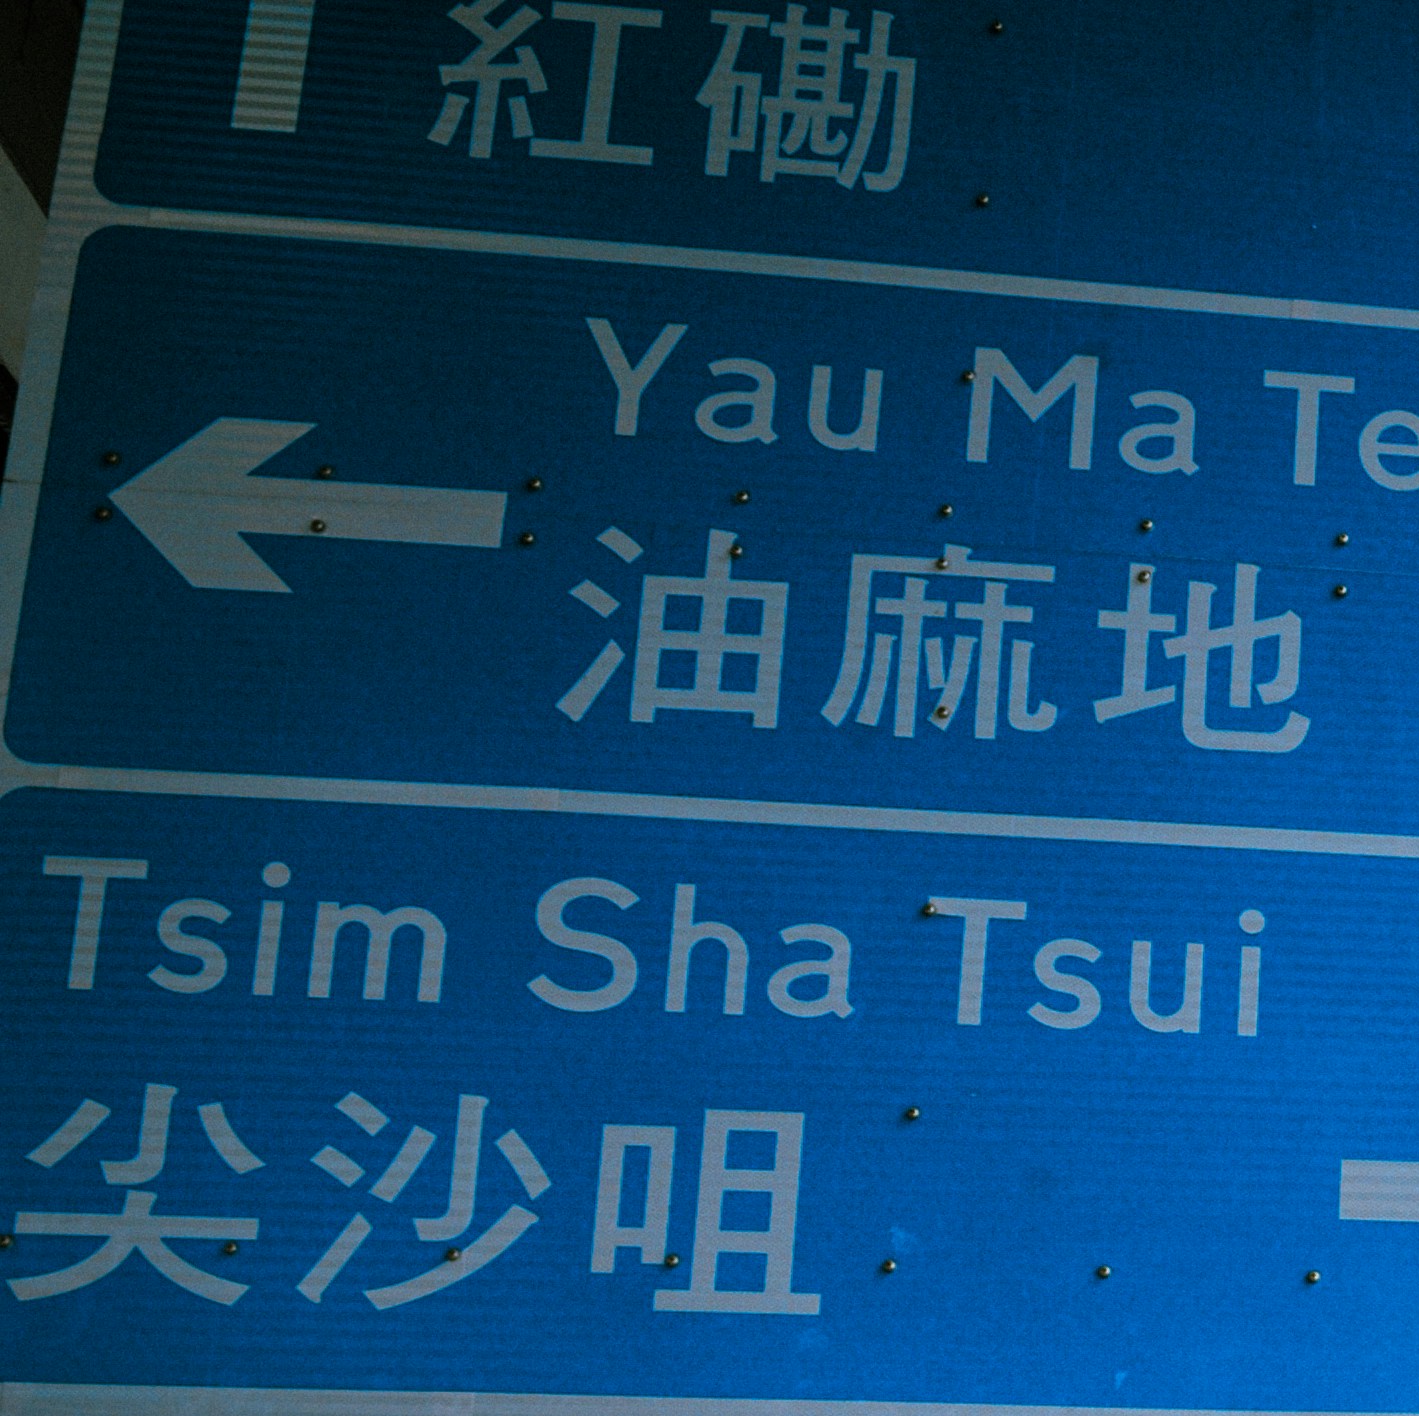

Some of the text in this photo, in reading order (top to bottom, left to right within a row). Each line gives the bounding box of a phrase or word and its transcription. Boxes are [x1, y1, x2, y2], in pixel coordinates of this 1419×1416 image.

[427, 0, 917, 193] 紅磡
[586, 317, 884, 453] Yau
[967, 346, 1200, 476] Ma
[555, 526, 1311, 754] 油麻地
[42, 855, 1266, 1037] Tsim Sha Tsui
[6, 1082, 822, 1315] 尖沙咀
